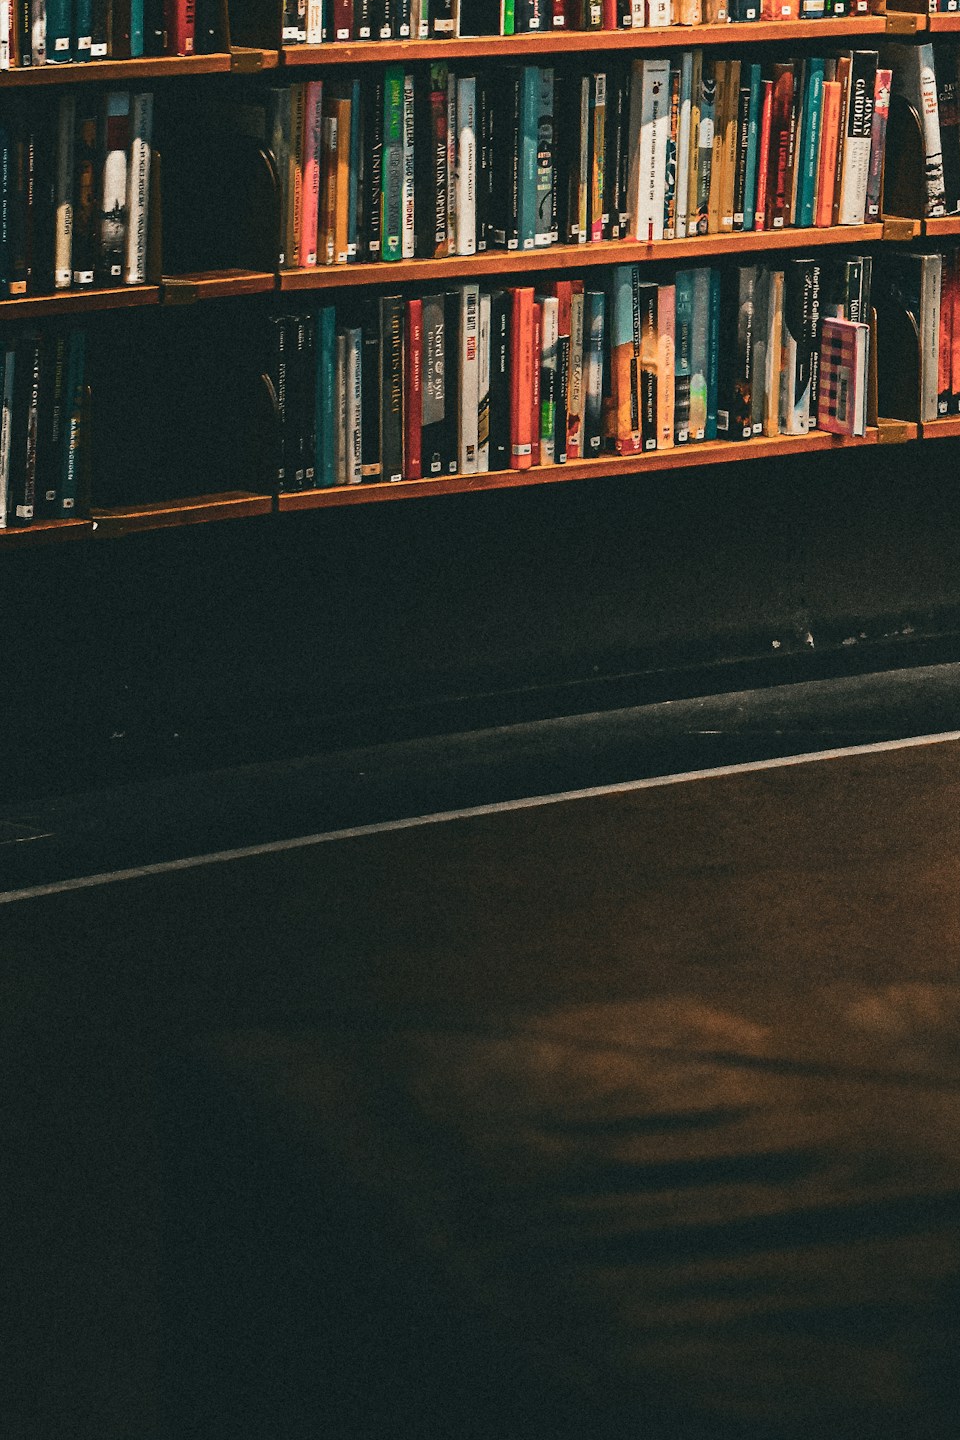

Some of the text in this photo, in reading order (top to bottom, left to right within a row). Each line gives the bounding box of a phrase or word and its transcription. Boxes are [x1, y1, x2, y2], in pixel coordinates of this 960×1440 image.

[853, 79, 863, 136] GARDELL
[863, 97, 873, 136] JONAS
[811, 266, 820, 337] Martha Gellhorn
[434, 324, 444, 356] Nord
[433, 379, 444, 399] syd
